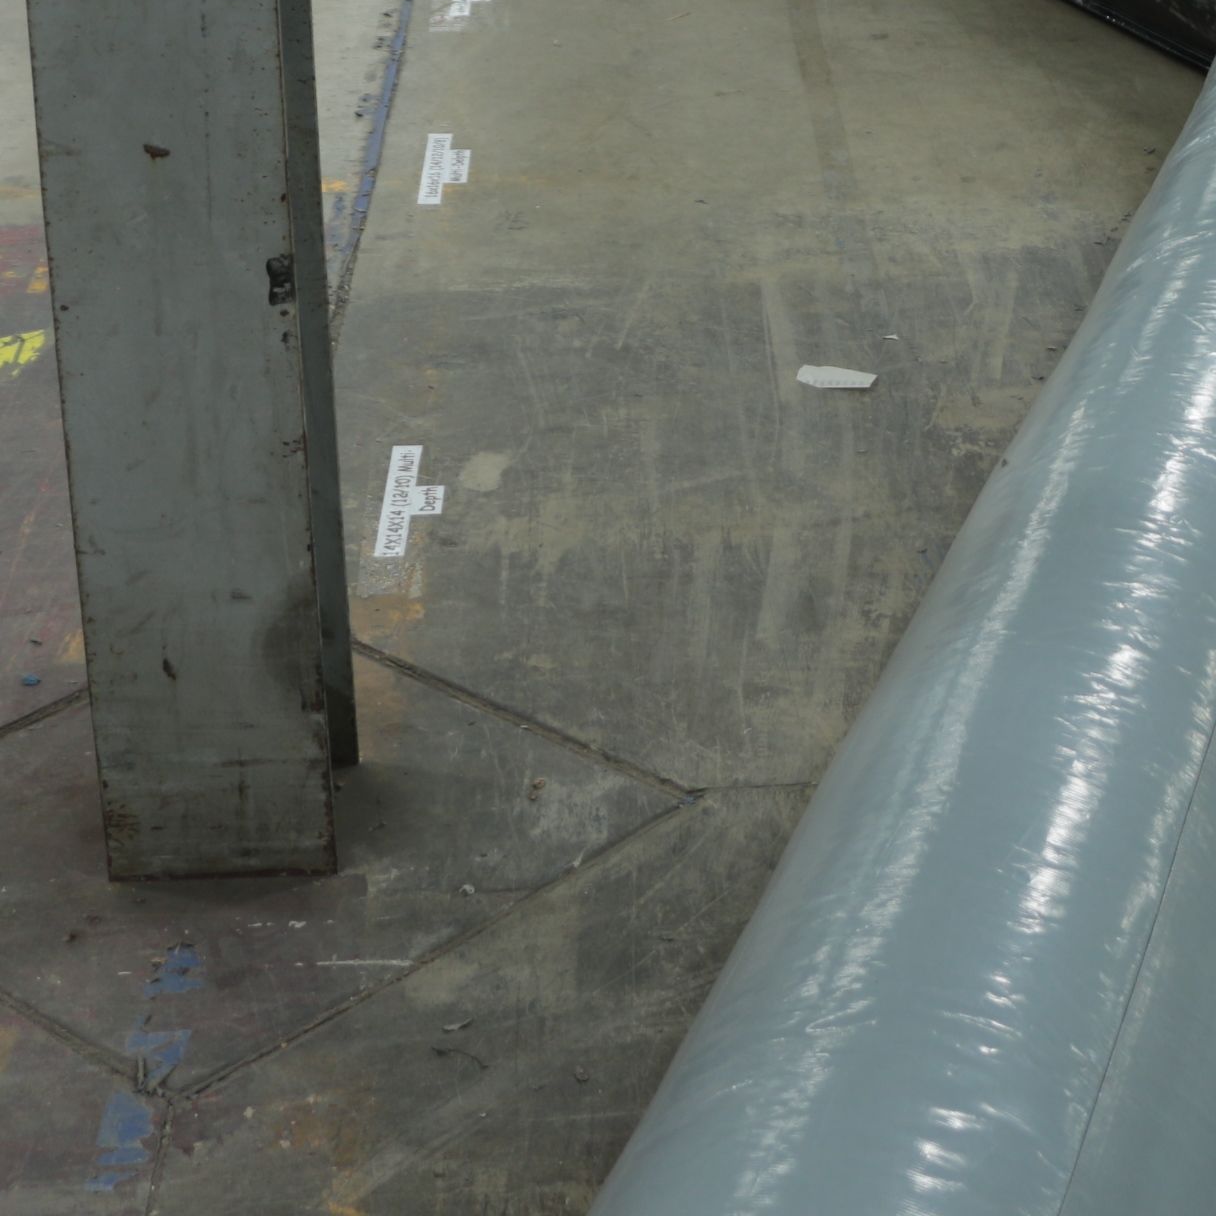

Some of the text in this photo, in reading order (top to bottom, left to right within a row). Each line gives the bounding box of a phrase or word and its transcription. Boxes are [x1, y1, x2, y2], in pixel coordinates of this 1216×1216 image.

[383, 449, 417, 557] 14X14X14 (12/10) Multi-
[418, 486, 442, 512] Depth
